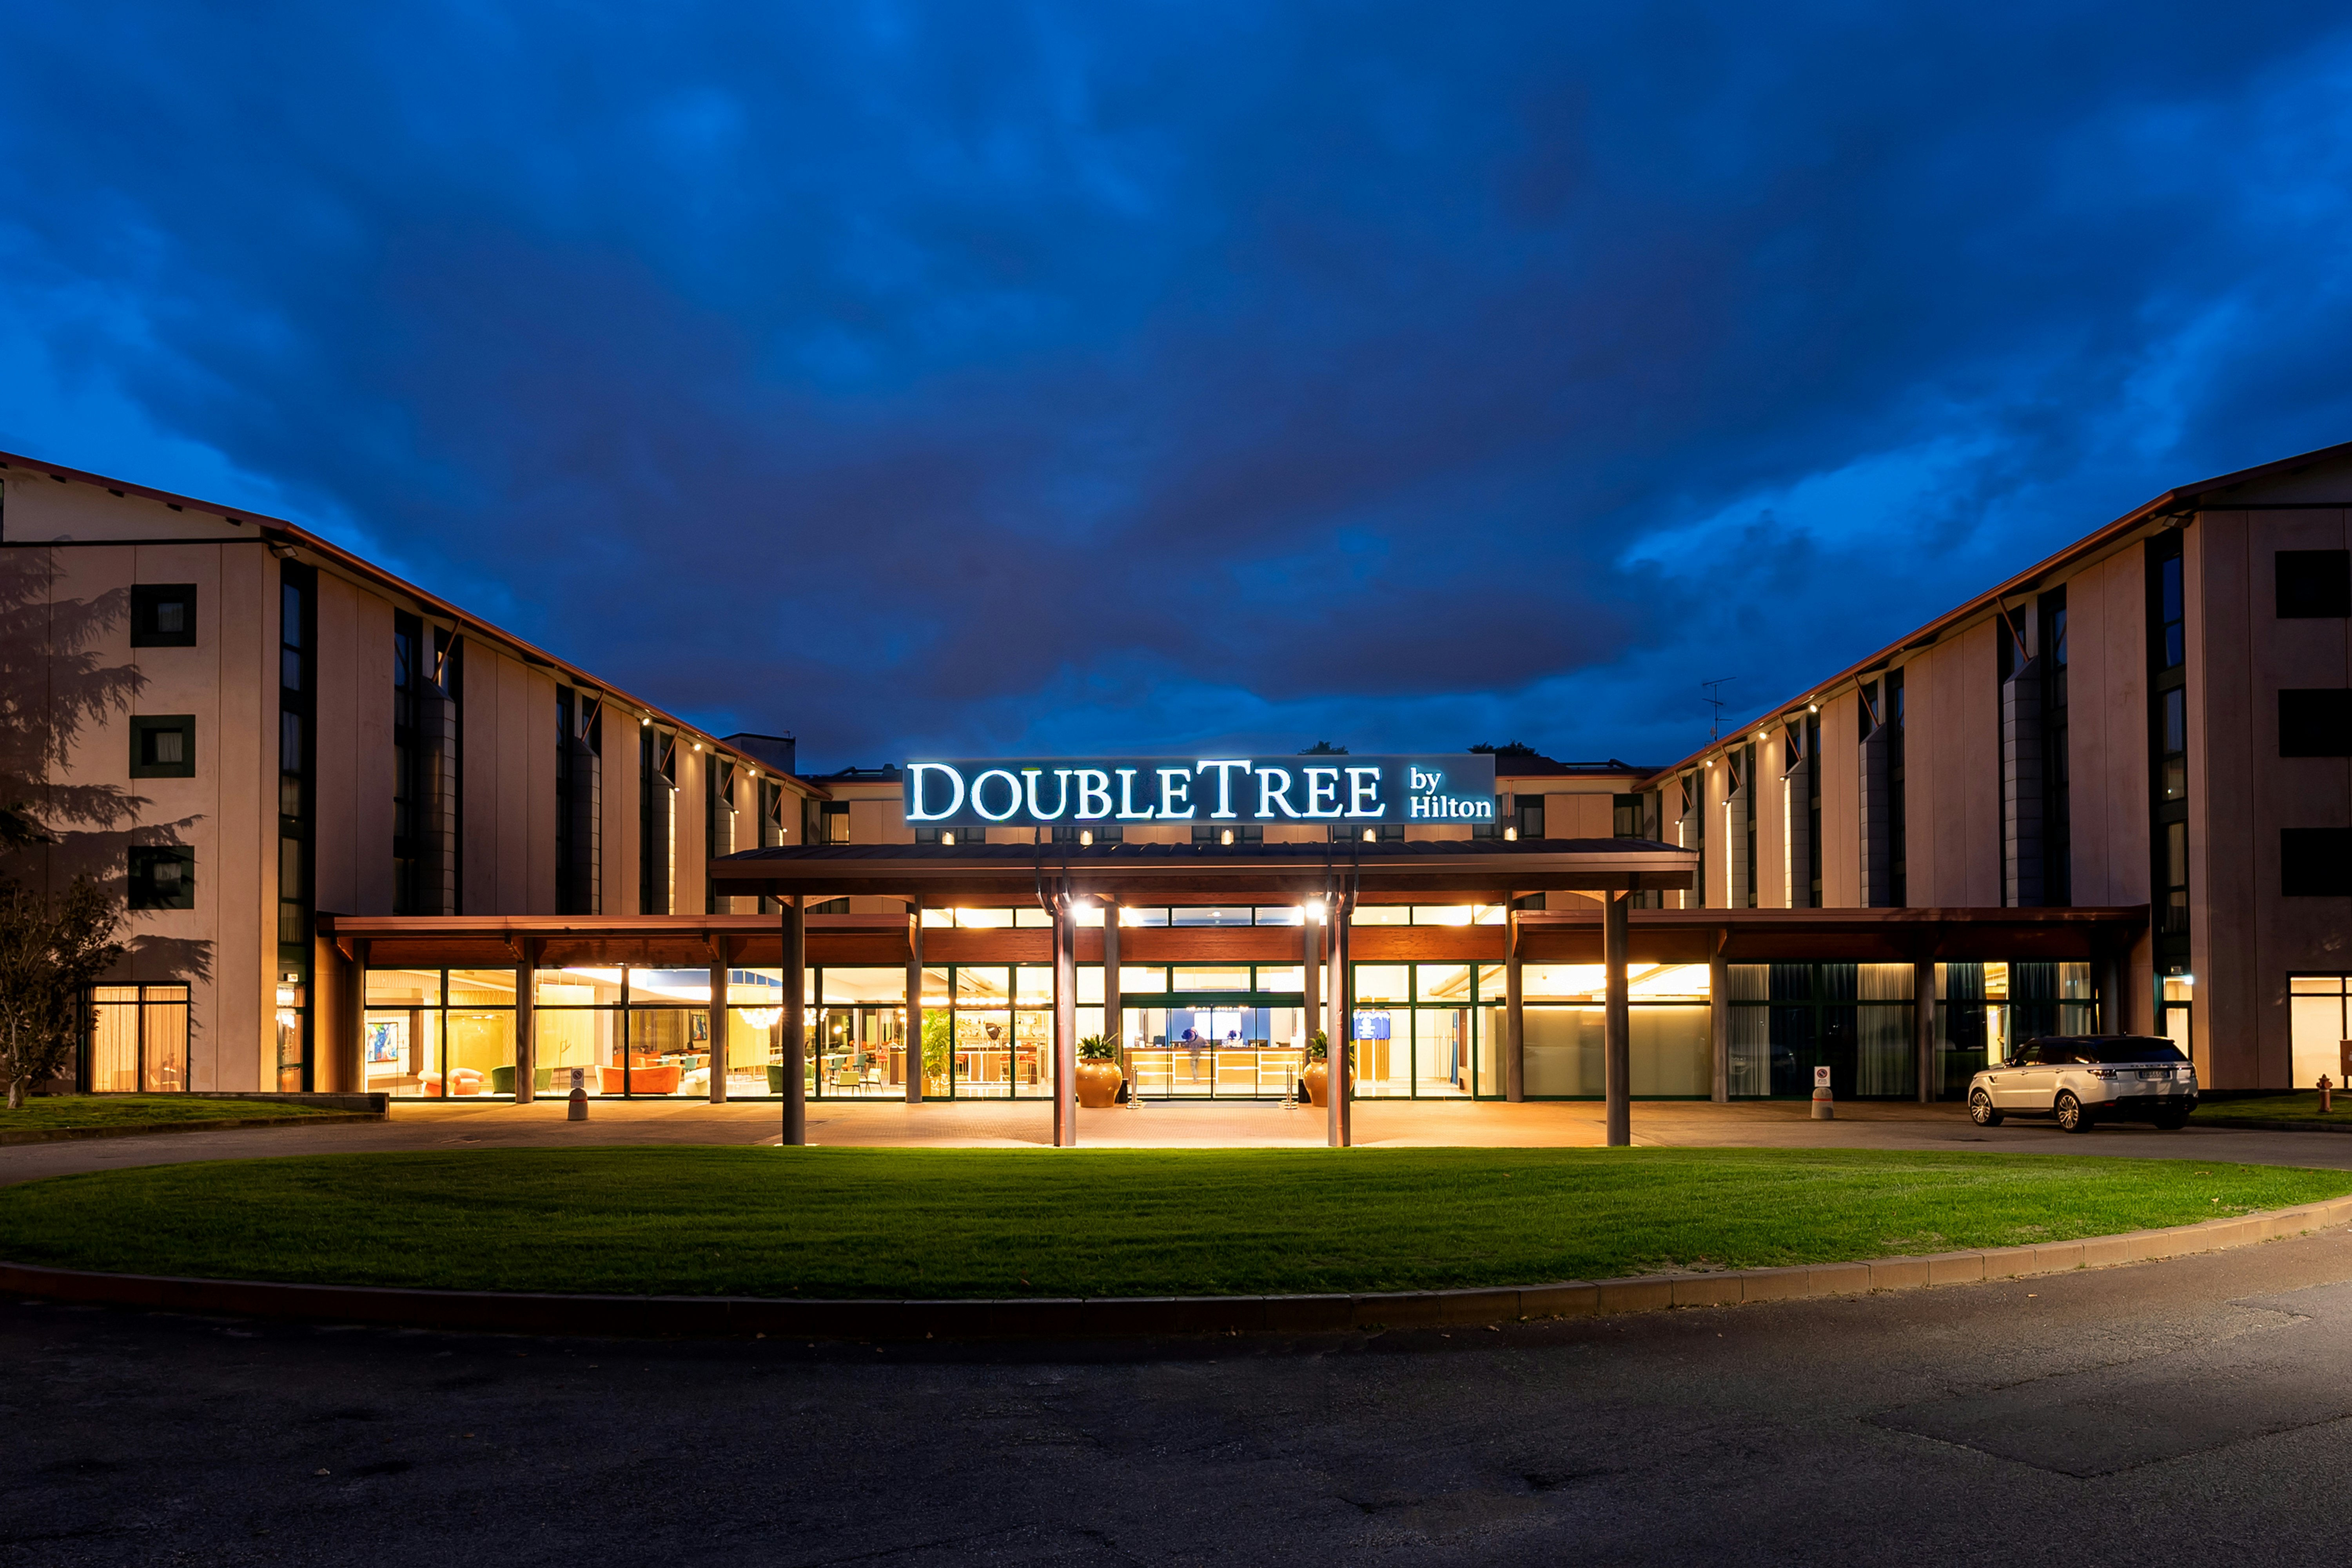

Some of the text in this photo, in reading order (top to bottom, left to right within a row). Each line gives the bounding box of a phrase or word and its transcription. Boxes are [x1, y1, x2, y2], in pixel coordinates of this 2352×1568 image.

[906, 760, 1385, 820] DOUBLETREE
[1410, 767, 1442, 795] by
[1410, 795, 1492, 818] Hilton
